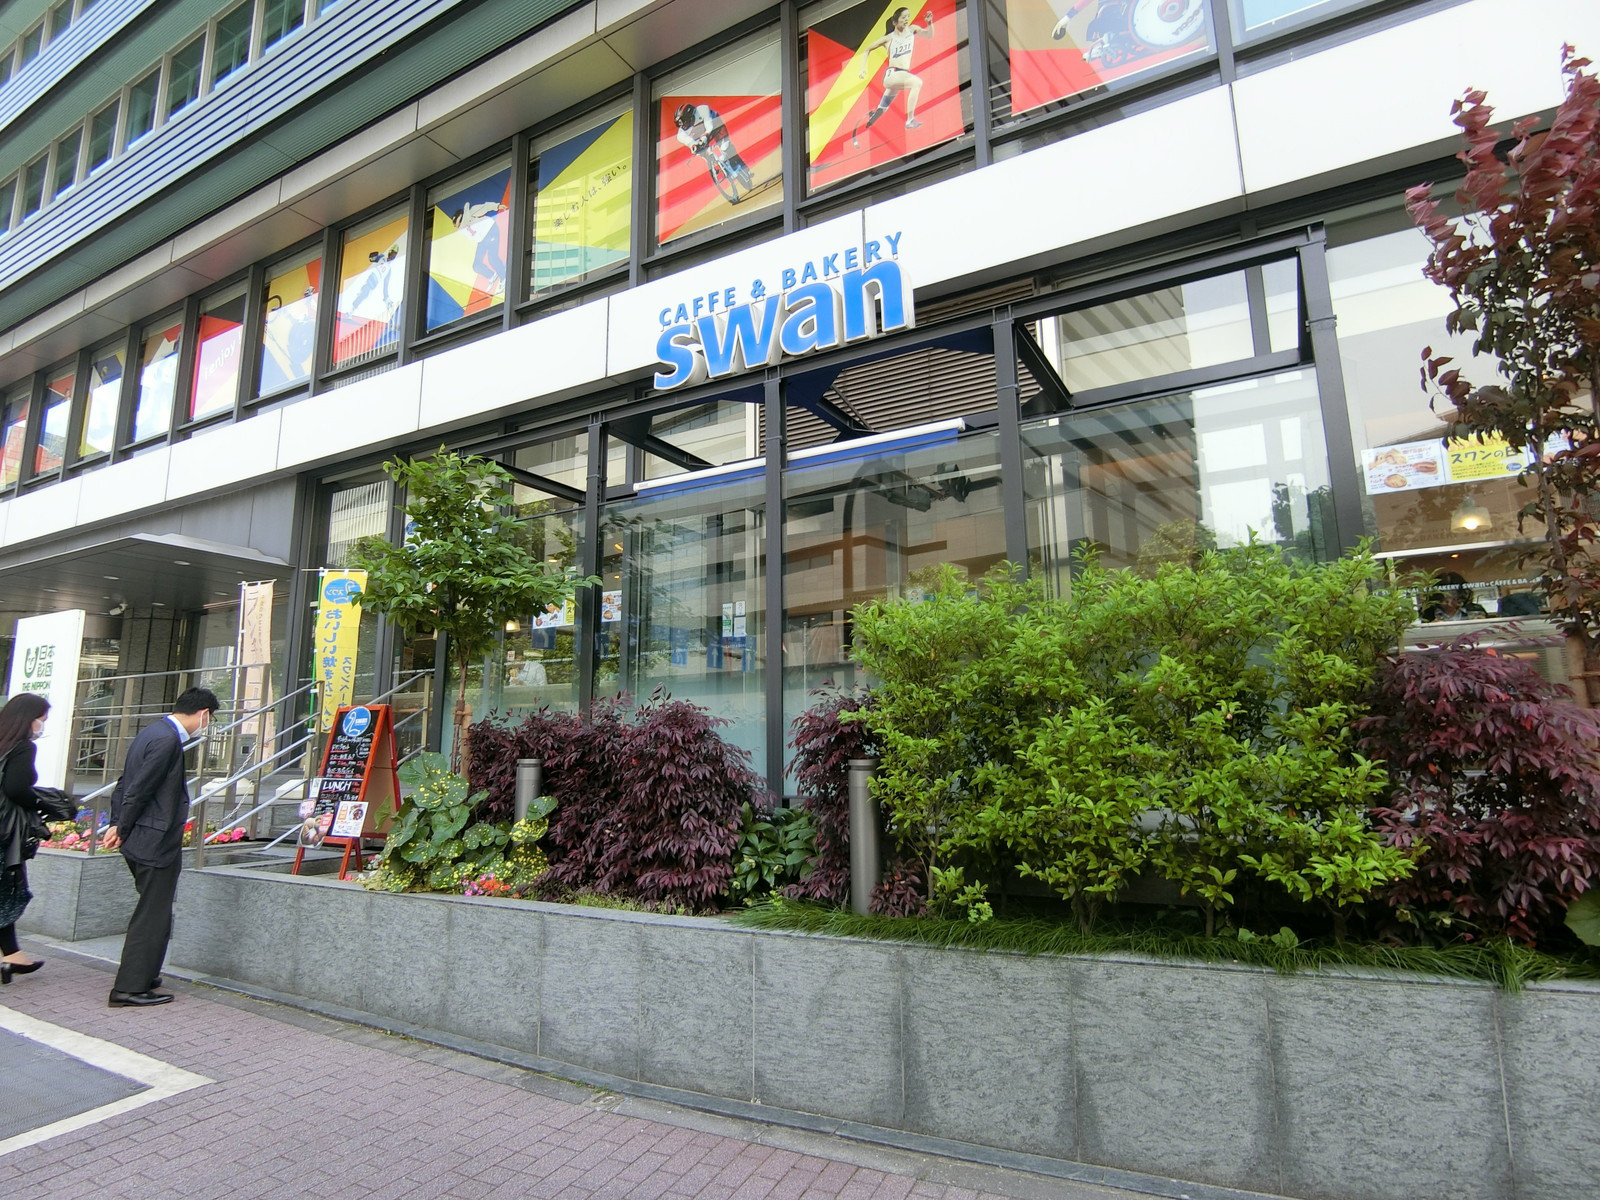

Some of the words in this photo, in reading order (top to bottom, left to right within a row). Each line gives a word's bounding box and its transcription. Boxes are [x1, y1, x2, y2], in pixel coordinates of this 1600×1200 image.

[553, 164, 627, 231] 楽しむ人は、強い。
[658, 286, 737, 327] CAFFE
[750, 278, 767, 299] &
[781, 231, 903, 290] BAKERY
[653, 260, 912, 391] swan
[208, 339, 236, 374] enjoy
[39, 644, 56, 660] 日本
[22, 682, 31, 691] THE
[31, 680, 51, 690] NIPPON
[322, 780, 353, 791] LUNCH
